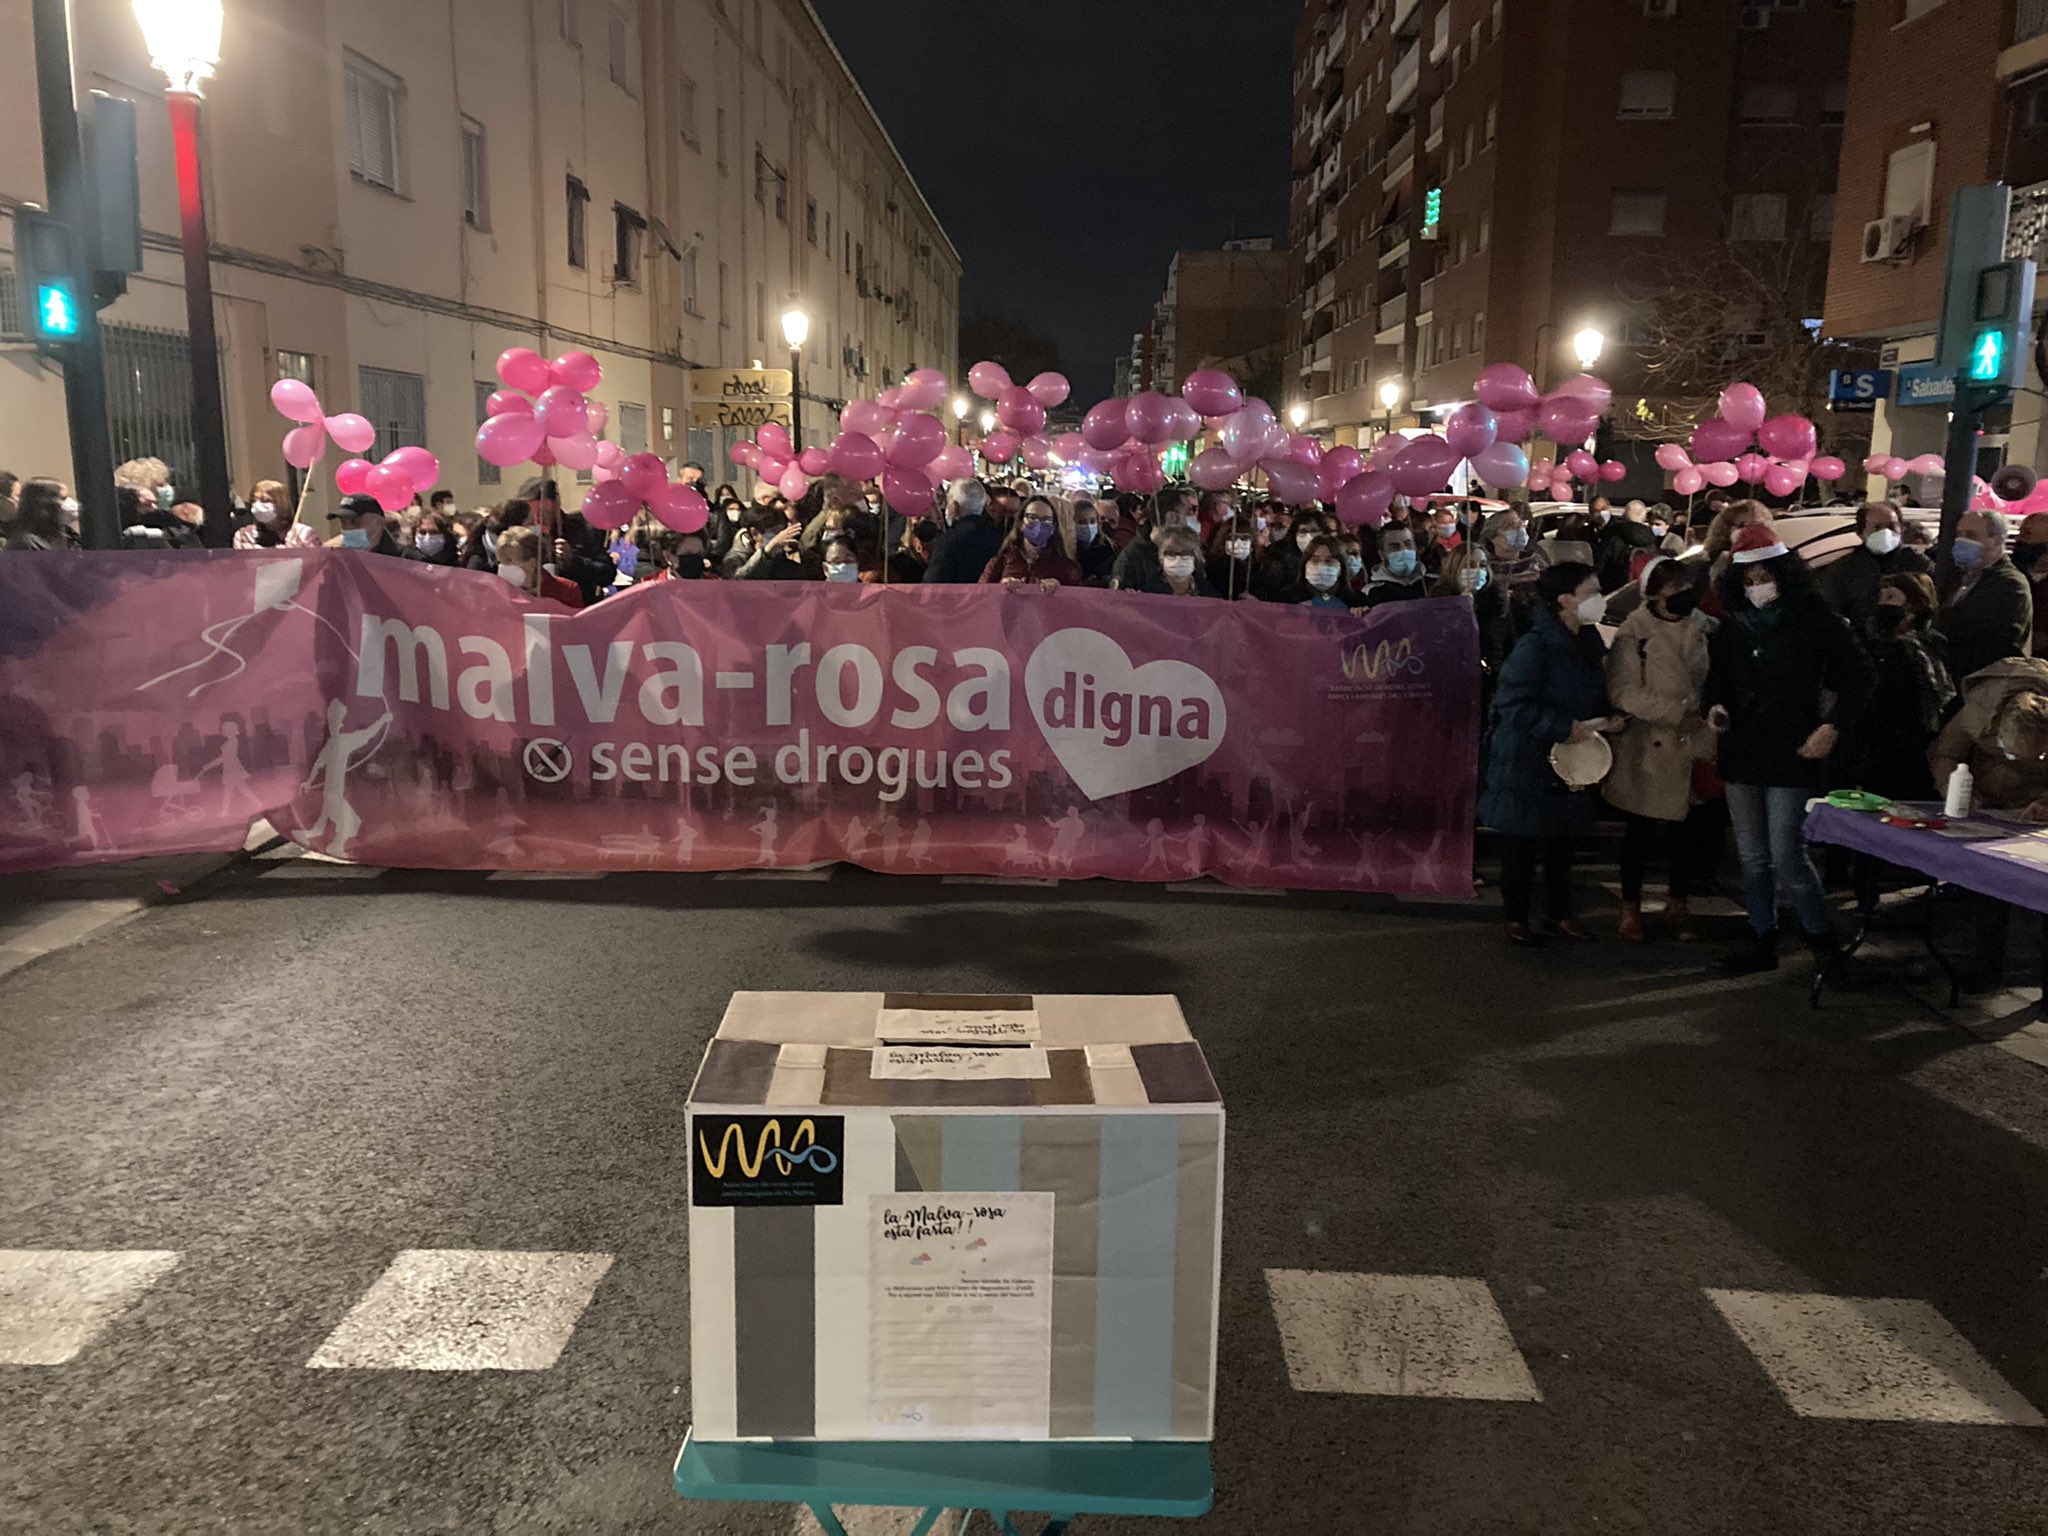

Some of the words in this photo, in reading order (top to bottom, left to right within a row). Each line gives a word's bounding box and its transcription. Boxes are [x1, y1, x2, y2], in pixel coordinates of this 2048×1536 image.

[1856, 374, 1874, 397] S
[357, 614, 1010, 731] malva-rosa
[1043, 672, 1210, 747] digna
[592, 741, 756, 785] sense
[775, 729, 1013, 801] drogues
